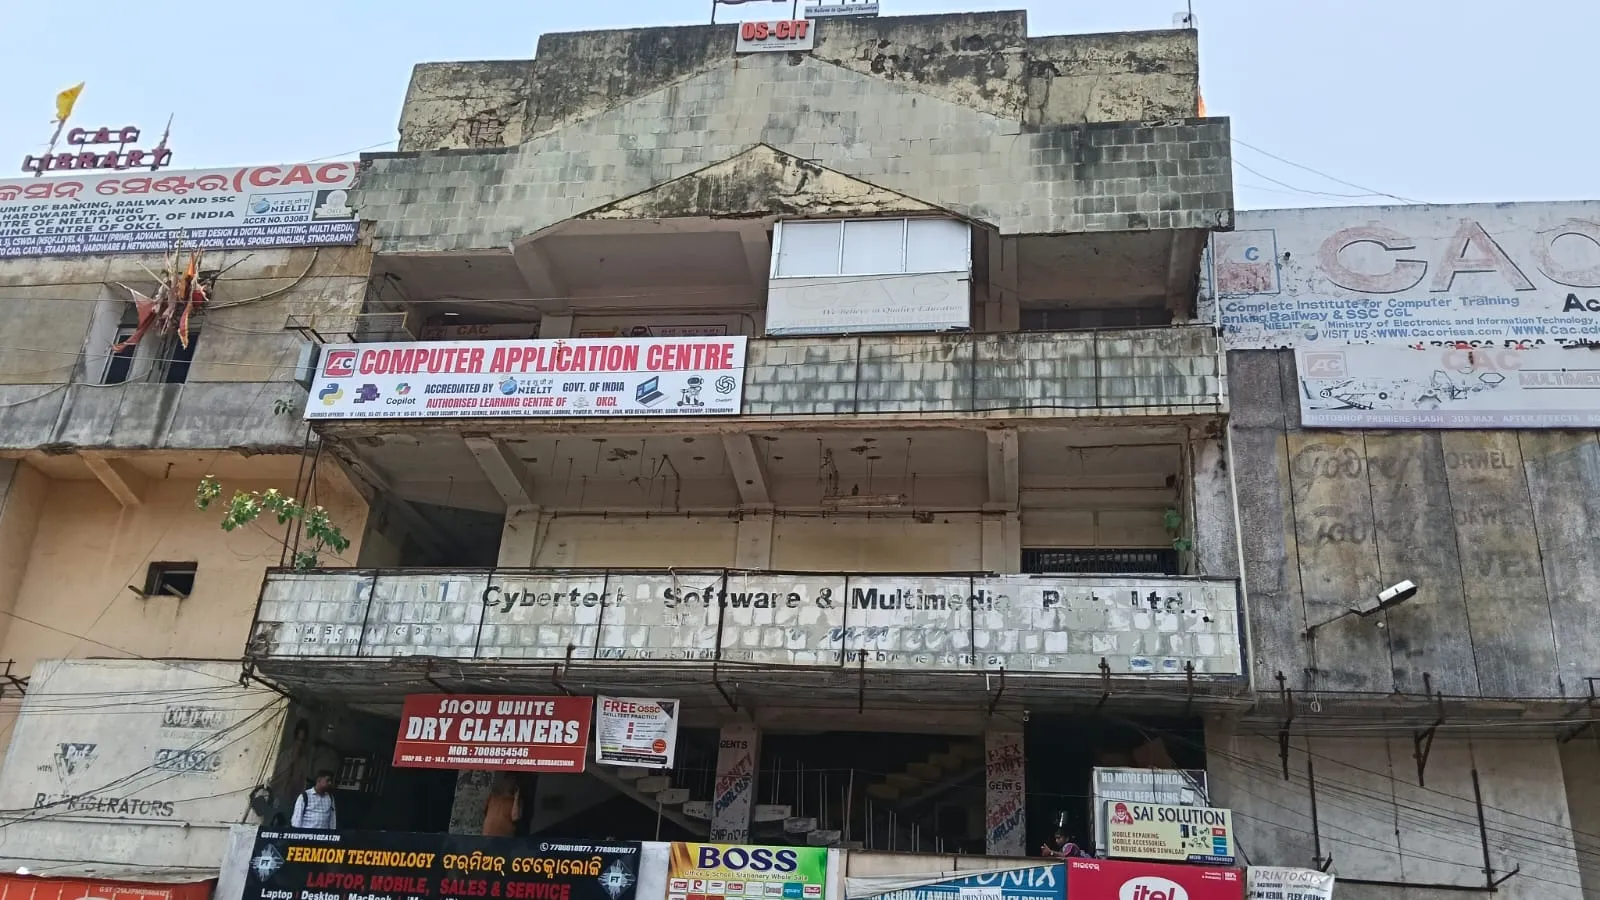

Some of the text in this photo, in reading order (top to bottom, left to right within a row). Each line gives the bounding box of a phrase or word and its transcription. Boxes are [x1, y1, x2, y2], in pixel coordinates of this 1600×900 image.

[742, 21, 809, 41] OS-CIT
[67, 126, 137, 145] CAC
[22, 149, 170, 172] LIBRARY
[1, 205, 28, 213] UNIT
[52, 201, 112, 212] BANKING,
[117, 198, 174, 207] RAILWAY
[179, 197, 207, 205] AND
[271, 205, 309, 213] NIELIT
[0, 210, 235, 227] TRE OF NIELIT, GOVT. OF INDIA
[3, 207, 144, 220] HARDWARE TRAINING
[286, 214, 309, 222] 03083
[36, 225, 94, 234] CENTRE
[124, 222, 164, 230] OKCL
[135, 231, 168, 241] ADVANCE
[309, 224, 329, 233] MULTI
[330, 222, 355, 233] MEDIA,
[247, 235, 278, 246] SPOKEN
[1226, 297, 1520, 312] Complete Institute for Computer Training
[1333, 311, 1344, 320] &
[1347, 309, 1379, 319] SSC
[1384, 308, 1413, 318] CGL
[1264, 321, 1300, 330] NIELIT
[1378, 320, 1390, 328] of
[1394, 317, 1451, 327] Electronics
[1456, 316, 1474, 325] and
[1477, 315, 1534, 325] Information
[1322, 330, 1349, 338] VISIT
[1355, 329, 1368, 338] US
[360, 343, 735, 375] COMPUTER APPLICATION CENTRE
[1441, 350, 1522, 371] CAC
[424, 384, 480, 394] ACCREDIATED
[483, 383, 495, 393] BY
[518, 386, 552, 394] NIELIT
[563, 382, 588, 392] GOVT.
[590, 382, 600, 391] OF
[602, 381, 625, 392] INDIA
[386, 397, 416, 406] Copilot
[426, 396, 618, 408] AUTHORISED LEARNING CENTRE OF OKCL
[662, 585, 801, 610] Software
[815, 588, 836, 609] &
[439, 699, 556, 716] SNOW WHITE
[603, 700, 637, 713] FREE
[405, 716, 451, 741] DRY
[459, 717, 581, 745] CLEANERS
[449, 745, 468, 756] MOB
[474, 747, 529, 758] 7008854546
[989, 781, 1022, 790] GENTS
[1133, 805, 1226, 826] SAI SOLUTION
[1111, 830, 1131, 838] MOBILE
[286, 846, 435, 869] FERMION TECHNOLOGY
[697, 847, 798, 872] BOSS
[307, 872, 572, 900] LAPTOP, MOBILE, SALES & SERVICE
[261, 888, 293, 900] Laptop
